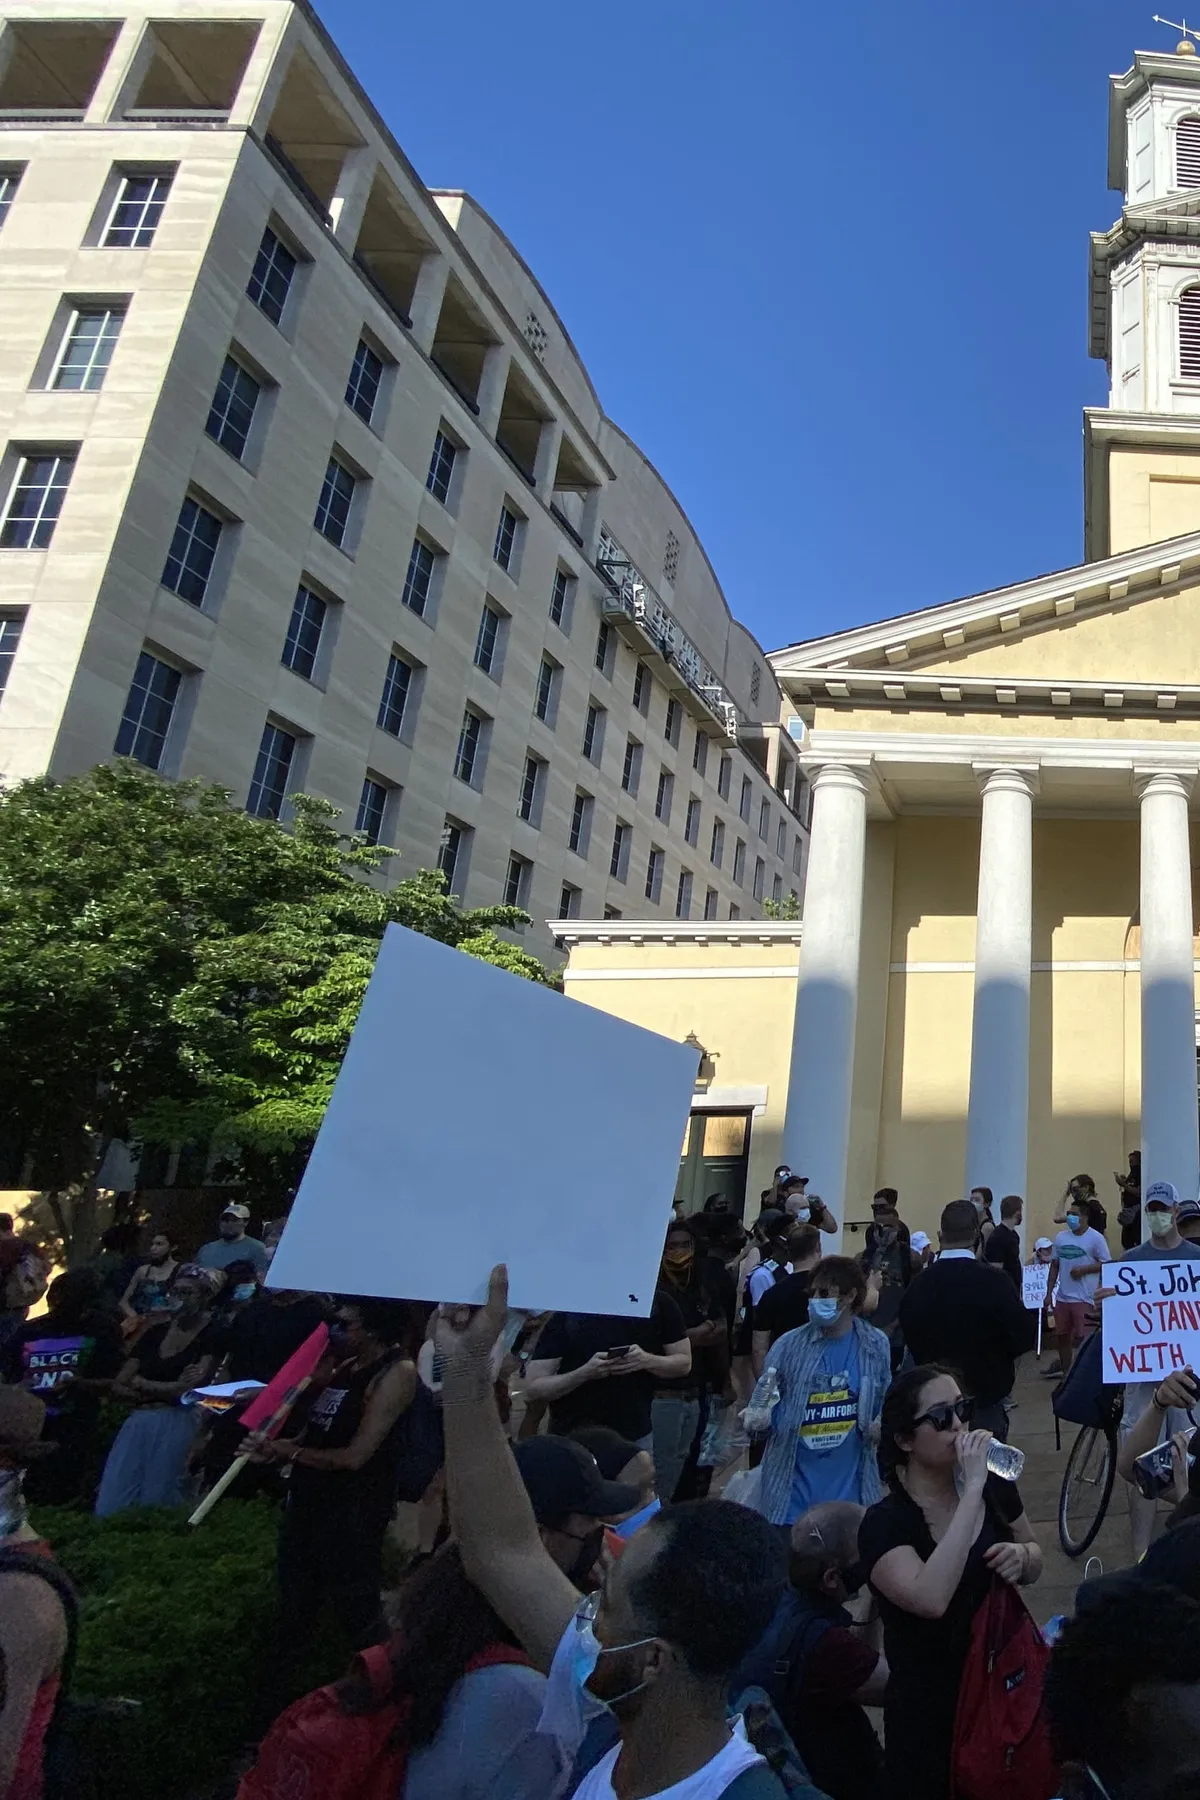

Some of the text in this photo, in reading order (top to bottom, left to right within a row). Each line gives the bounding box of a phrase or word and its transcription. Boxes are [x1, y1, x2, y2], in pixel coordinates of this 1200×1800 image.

[1025, 1263, 1048, 1273] RACIS
[1036, 1272, 1046, 1280] IS
[1114, 1266, 1153, 1297] St.
[1109, 1342, 1185, 1374] WITH
